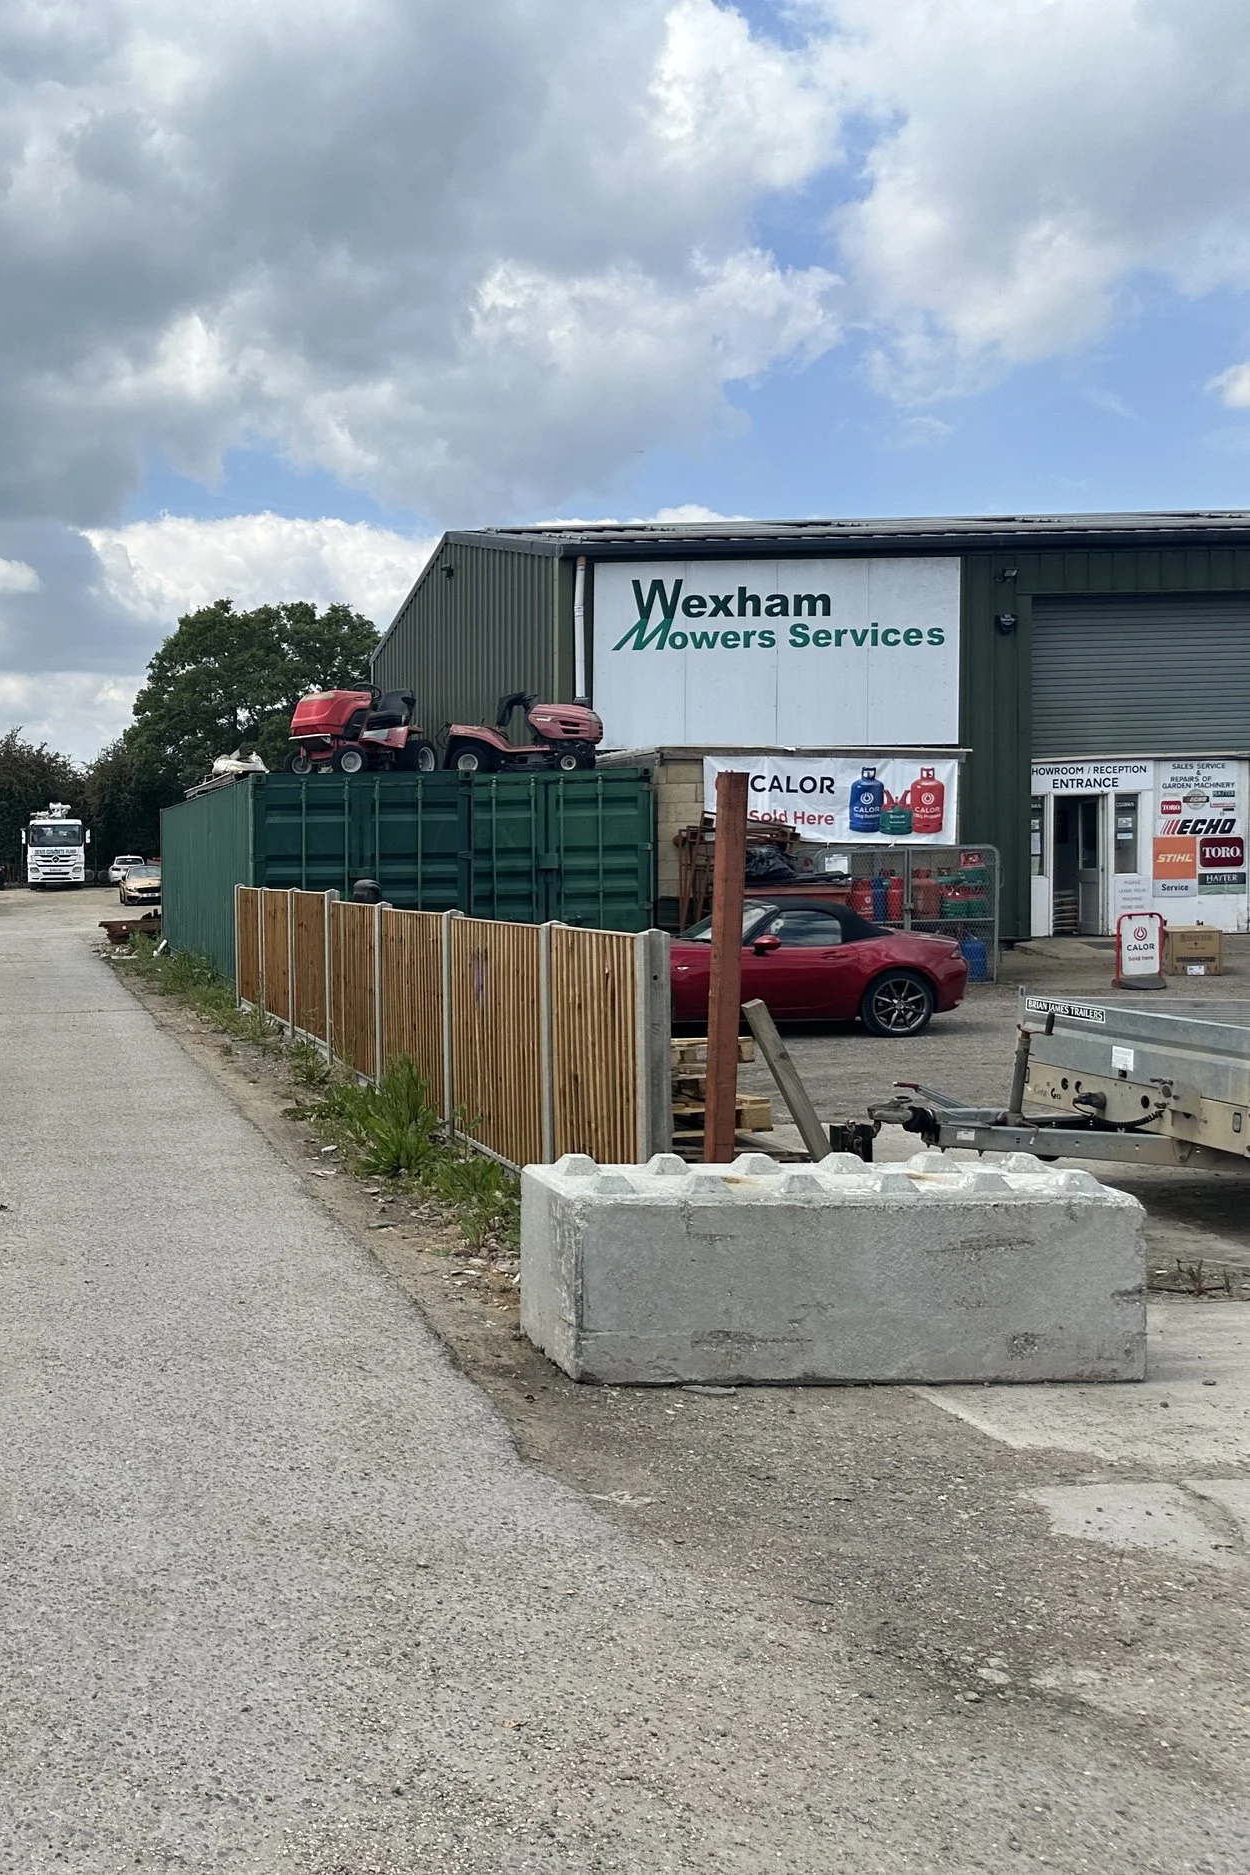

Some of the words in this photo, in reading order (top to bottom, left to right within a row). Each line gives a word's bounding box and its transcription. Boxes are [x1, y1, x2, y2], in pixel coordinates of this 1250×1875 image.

[631, 579, 831, 619] Wexham
[612, 619, 776, 651] Mowers
[788, 623, 945, 648] Services
[1031, 767, 1084, 775] HOWROOM
[1093, 765, 1147, 774] RECEPTION
[750, 775, 835, 794] CALOR
[1052, 777, 1119, 788] ENTRANCE
[750, 810, 787, 823] Sold
[794, 811, 835, 825] Here
[1177, 819, 1236, 834] ECHO
[1156, 853, 1193, 862] STIHL
[1202, 846, 1240, 858] TORO
[1126, 943, 1155, 951] CALOR
[1028, 1000, 1048, 1010] BRIAN
[1049, 1003, 1069, 1014] JAMES
[1070, 1006, 1103, 1020] TRAILERS
